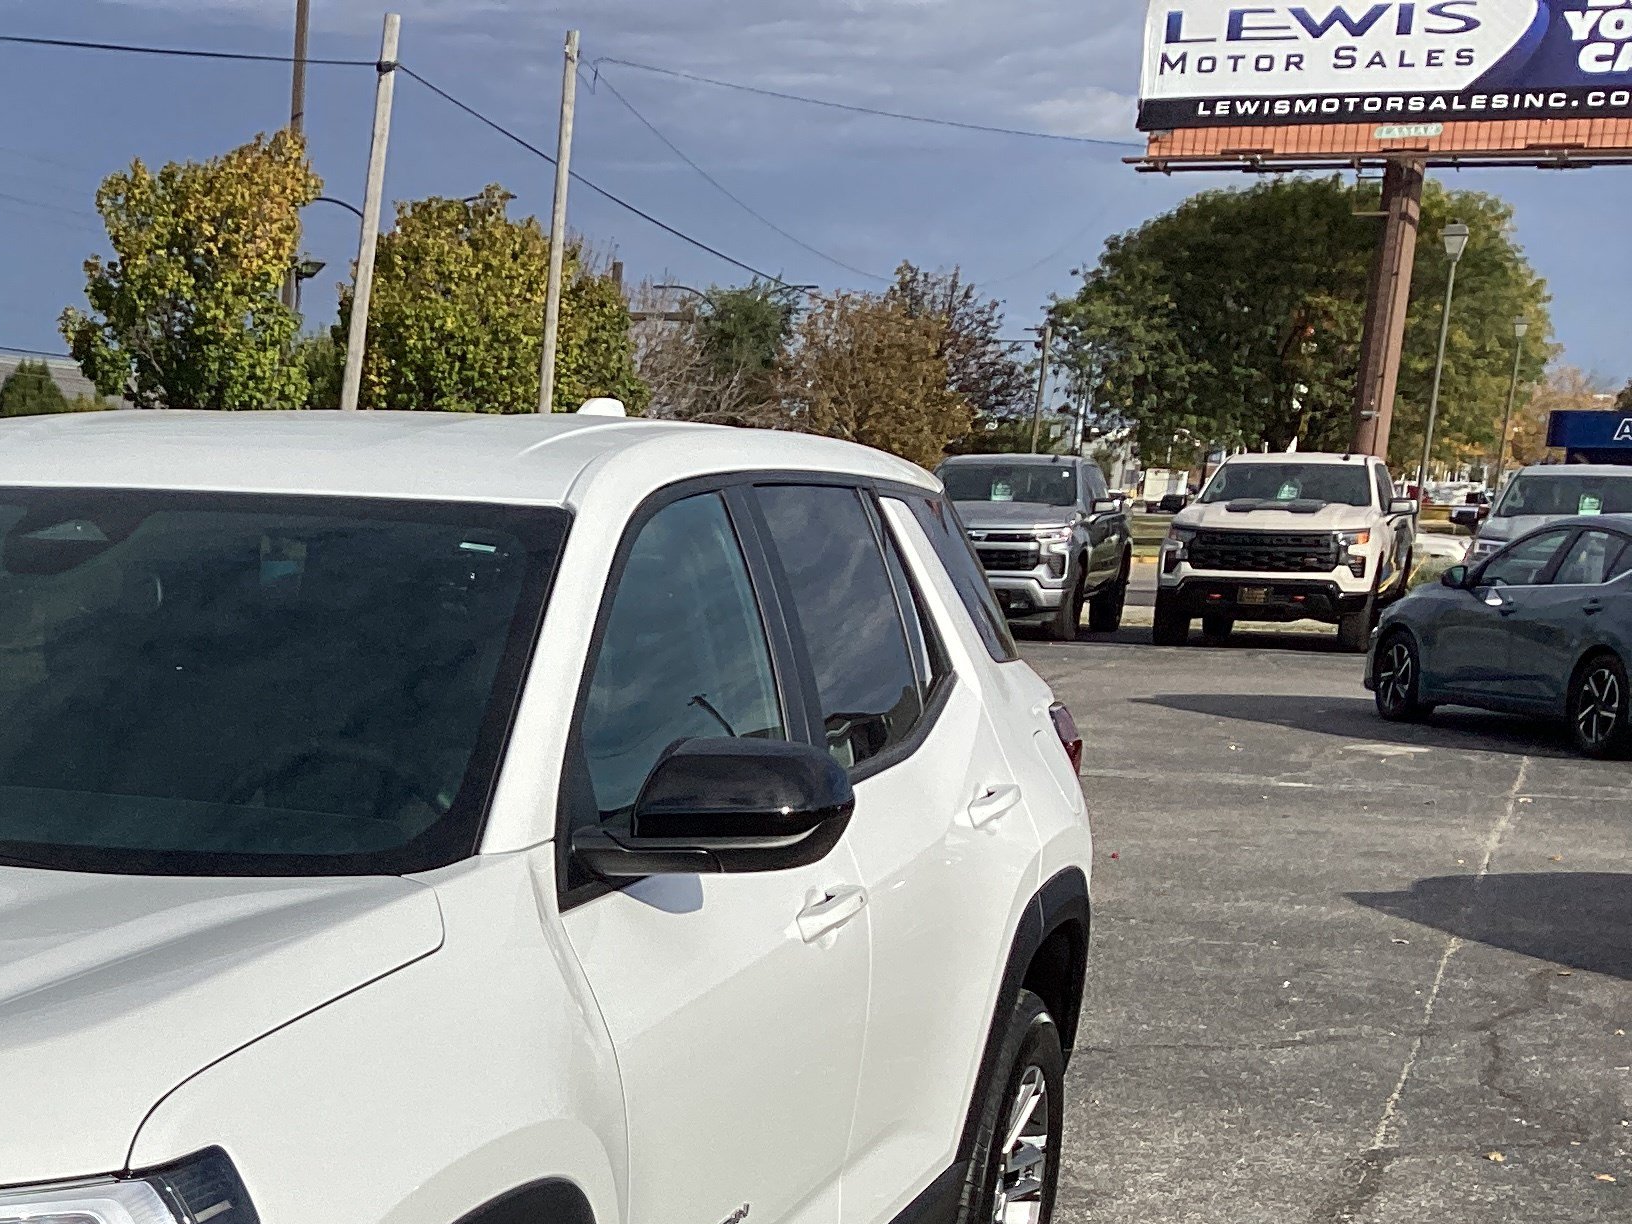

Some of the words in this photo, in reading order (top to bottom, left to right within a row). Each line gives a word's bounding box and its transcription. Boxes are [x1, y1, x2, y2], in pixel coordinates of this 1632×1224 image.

[1165, 1, 1481, 44] LEWIS
[1159, 51, 1304, 76] MOTOR
[1332, 45, 1474, 69] SALES
[1197, 90, 1630, 116] LEWISMOTORSALESINC.CO
